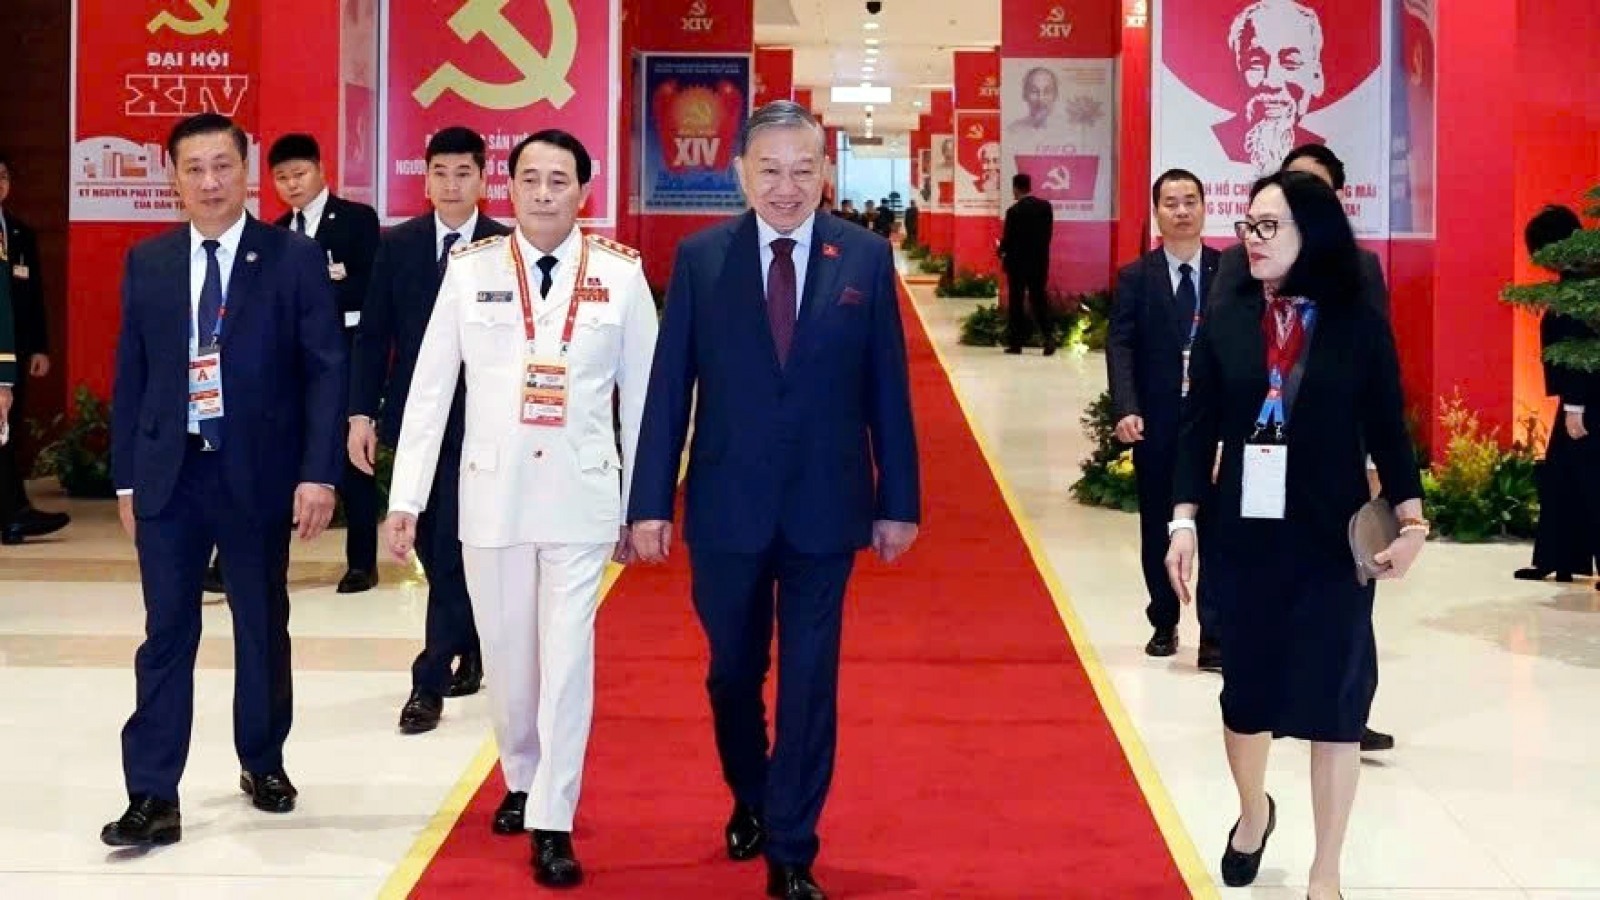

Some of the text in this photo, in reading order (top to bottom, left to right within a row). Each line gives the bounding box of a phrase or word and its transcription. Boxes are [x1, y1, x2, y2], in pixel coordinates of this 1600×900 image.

[681, 17, 713, 30] XIV
[1039, 23, 1072, 38] XIV
[146, 49, 229, 70] ĐẠI HỘI
[125, 73, 248, 116] XIV
[672, 137, 721, 167] XIV
